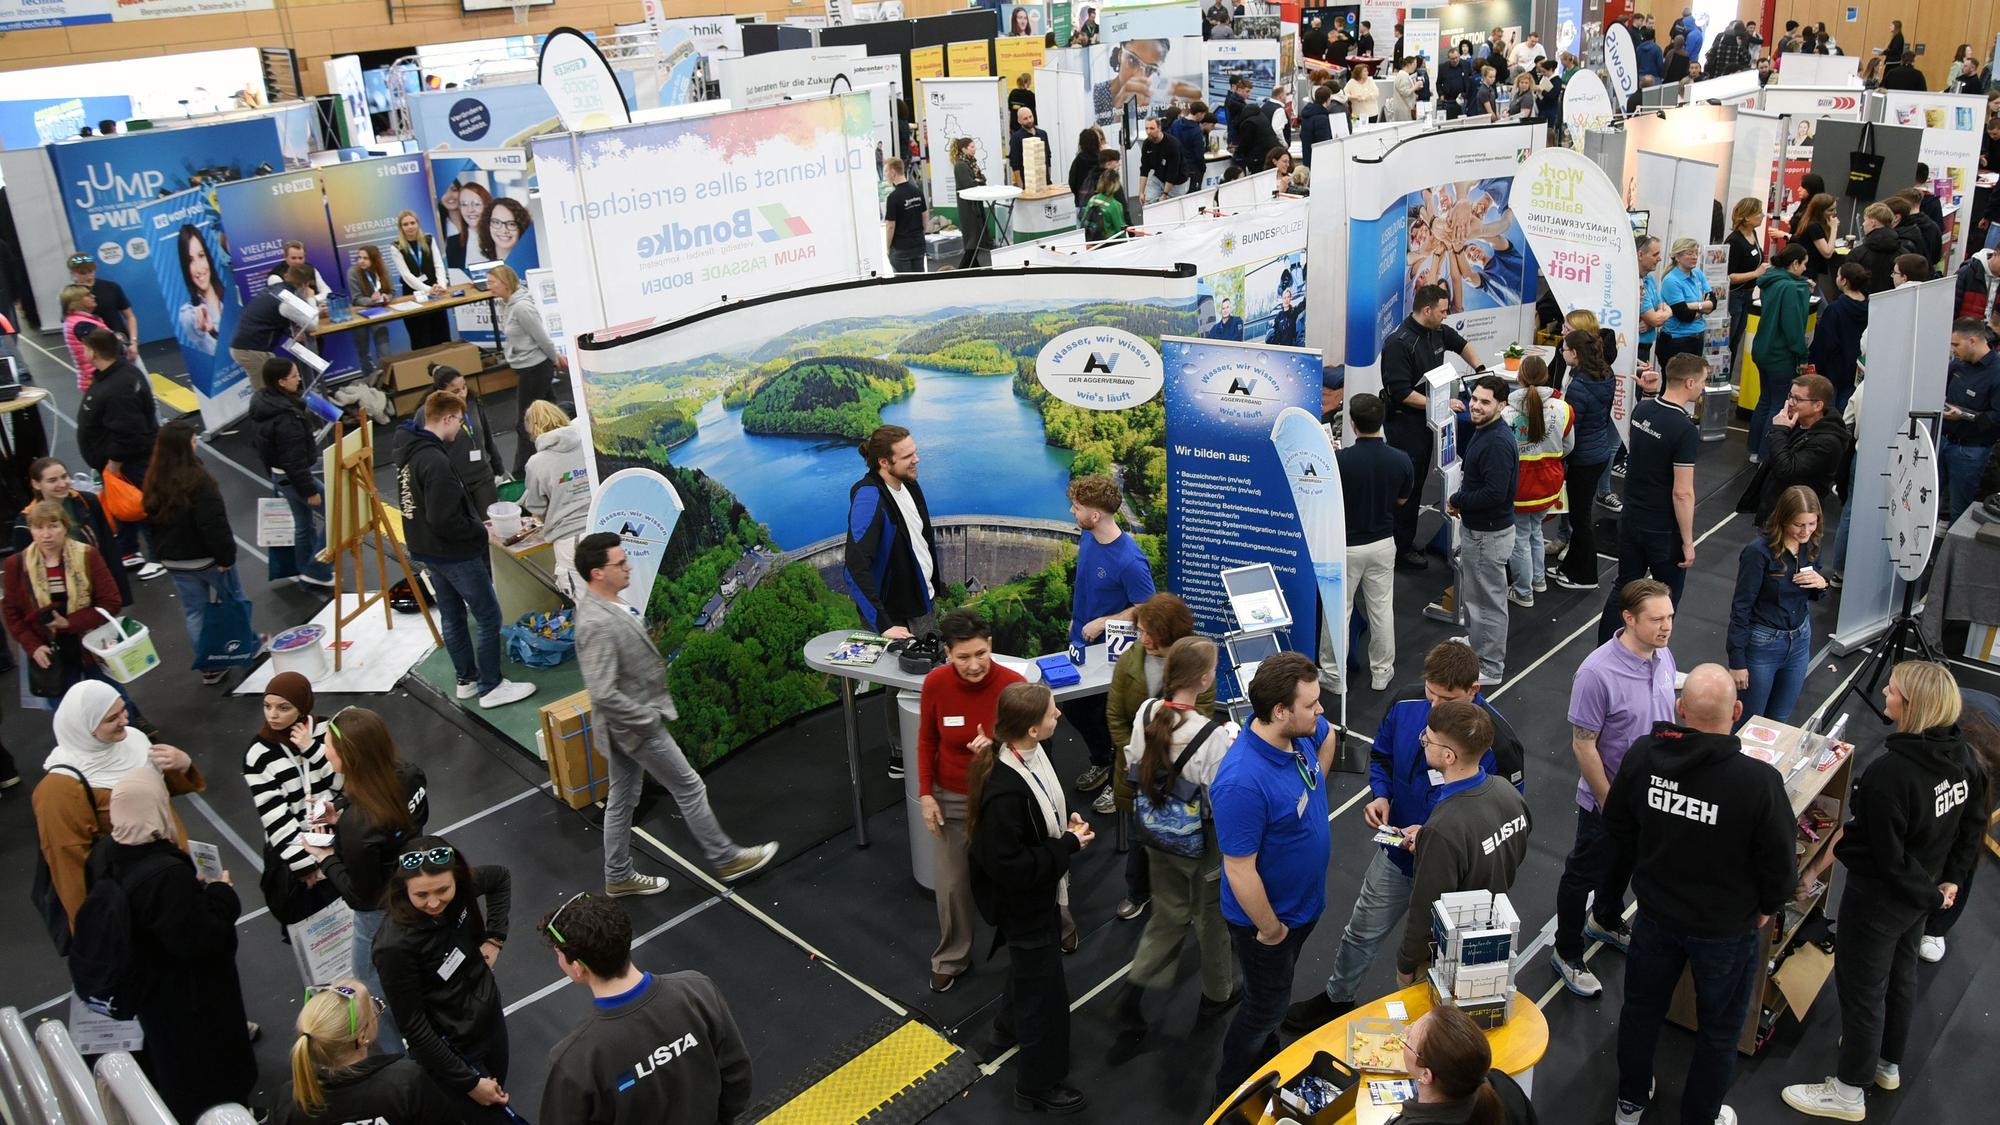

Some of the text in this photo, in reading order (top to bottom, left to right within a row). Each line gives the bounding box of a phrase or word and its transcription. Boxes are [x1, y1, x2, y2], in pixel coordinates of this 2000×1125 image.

[690, 22, 722, 35] hnik
[853, 64, 883, 74] jobcenter
[754, 83, 778, 94] beraten
[779, 79, 791, 88] für
[792, 78, 805, 87] die
[807, 76, 834, 85] Zukun
[1923, 148, 1971, 159] Verpackungen
[376, 160, 420, 178] stewe
[75, 162, 164, 209] JUMP
[271, 177, 315, 196] stewe
[343, 216, 399, 233] VERTRAUEN
[1241, 221, 1305, 246] BUNDESPOLIZEI
[240, 239, 283, 256] VIELFALT
[1051, 334, 1151, 368] Wasser, wir wissen
[1068, 376, 1135, 386] DER AGGERVERBAND
[1201, 362, 1281, 393] Wasser, wir wissen
[1107, 391, 1132, 403] läuft
[1220, 396, 1263, 406] AGGERVERBAND
[1243, 409, 1264, 419] läuft
[1174, 444, 1251, 463] Wir bilden aus:
[1181, 470, 1252, 486] Bauzeichner/in (m/w/d)
[1181, 480, 1262, 497] Chemielaborant/in (m/w/d)
[1181, 488, 1225, 500] Elektroniker/in
[1181, 498, 1294, 520] Fachrichtung Betriebstechnik (m/w/d)
[1181, 506, 1240, 520] Fachinformatiker/in
[599, 511, 627, 526] Wasser,
[644, 514, 668, 537] wissen
[1181, 515, 1302, 539] Fachrichtung Systemintegration (m/w/d)
[1181, 524, 1240, 538] Fachinformatiker/in
[1182, 533, 1297, 556] Fachrichtung Anwendungsentwicklung
[1182, 542, 1205, 551] (m/w/d)
[1182, 551, 1210, 560] Fachkraft
[1272, 564, 1297, 574] (m/w/d)
[1182, 559, 1210, 569] Fachkraft
[1211, 562, 1220, 570] für
[1182, 568, 1222, 579] Industrieserv
[1182, 576, 1210, 587] Fachkraft
[1182, 586, 1228, 598] versorgungstec
[1182, 594, 1216, 604] Forstwirt/in
[1107, 629, 1138, 637] Company
[1650, 774, 1679, 793] TEAM
[1934, 778, 1950, 795] TEAM
[407, 785, 426, 814] STA
[1648, 786, 1719, 825] GIZEH
[1494, 814, 1528, 846] LISTA
[634, 1032, 699, 1079] LISTA
